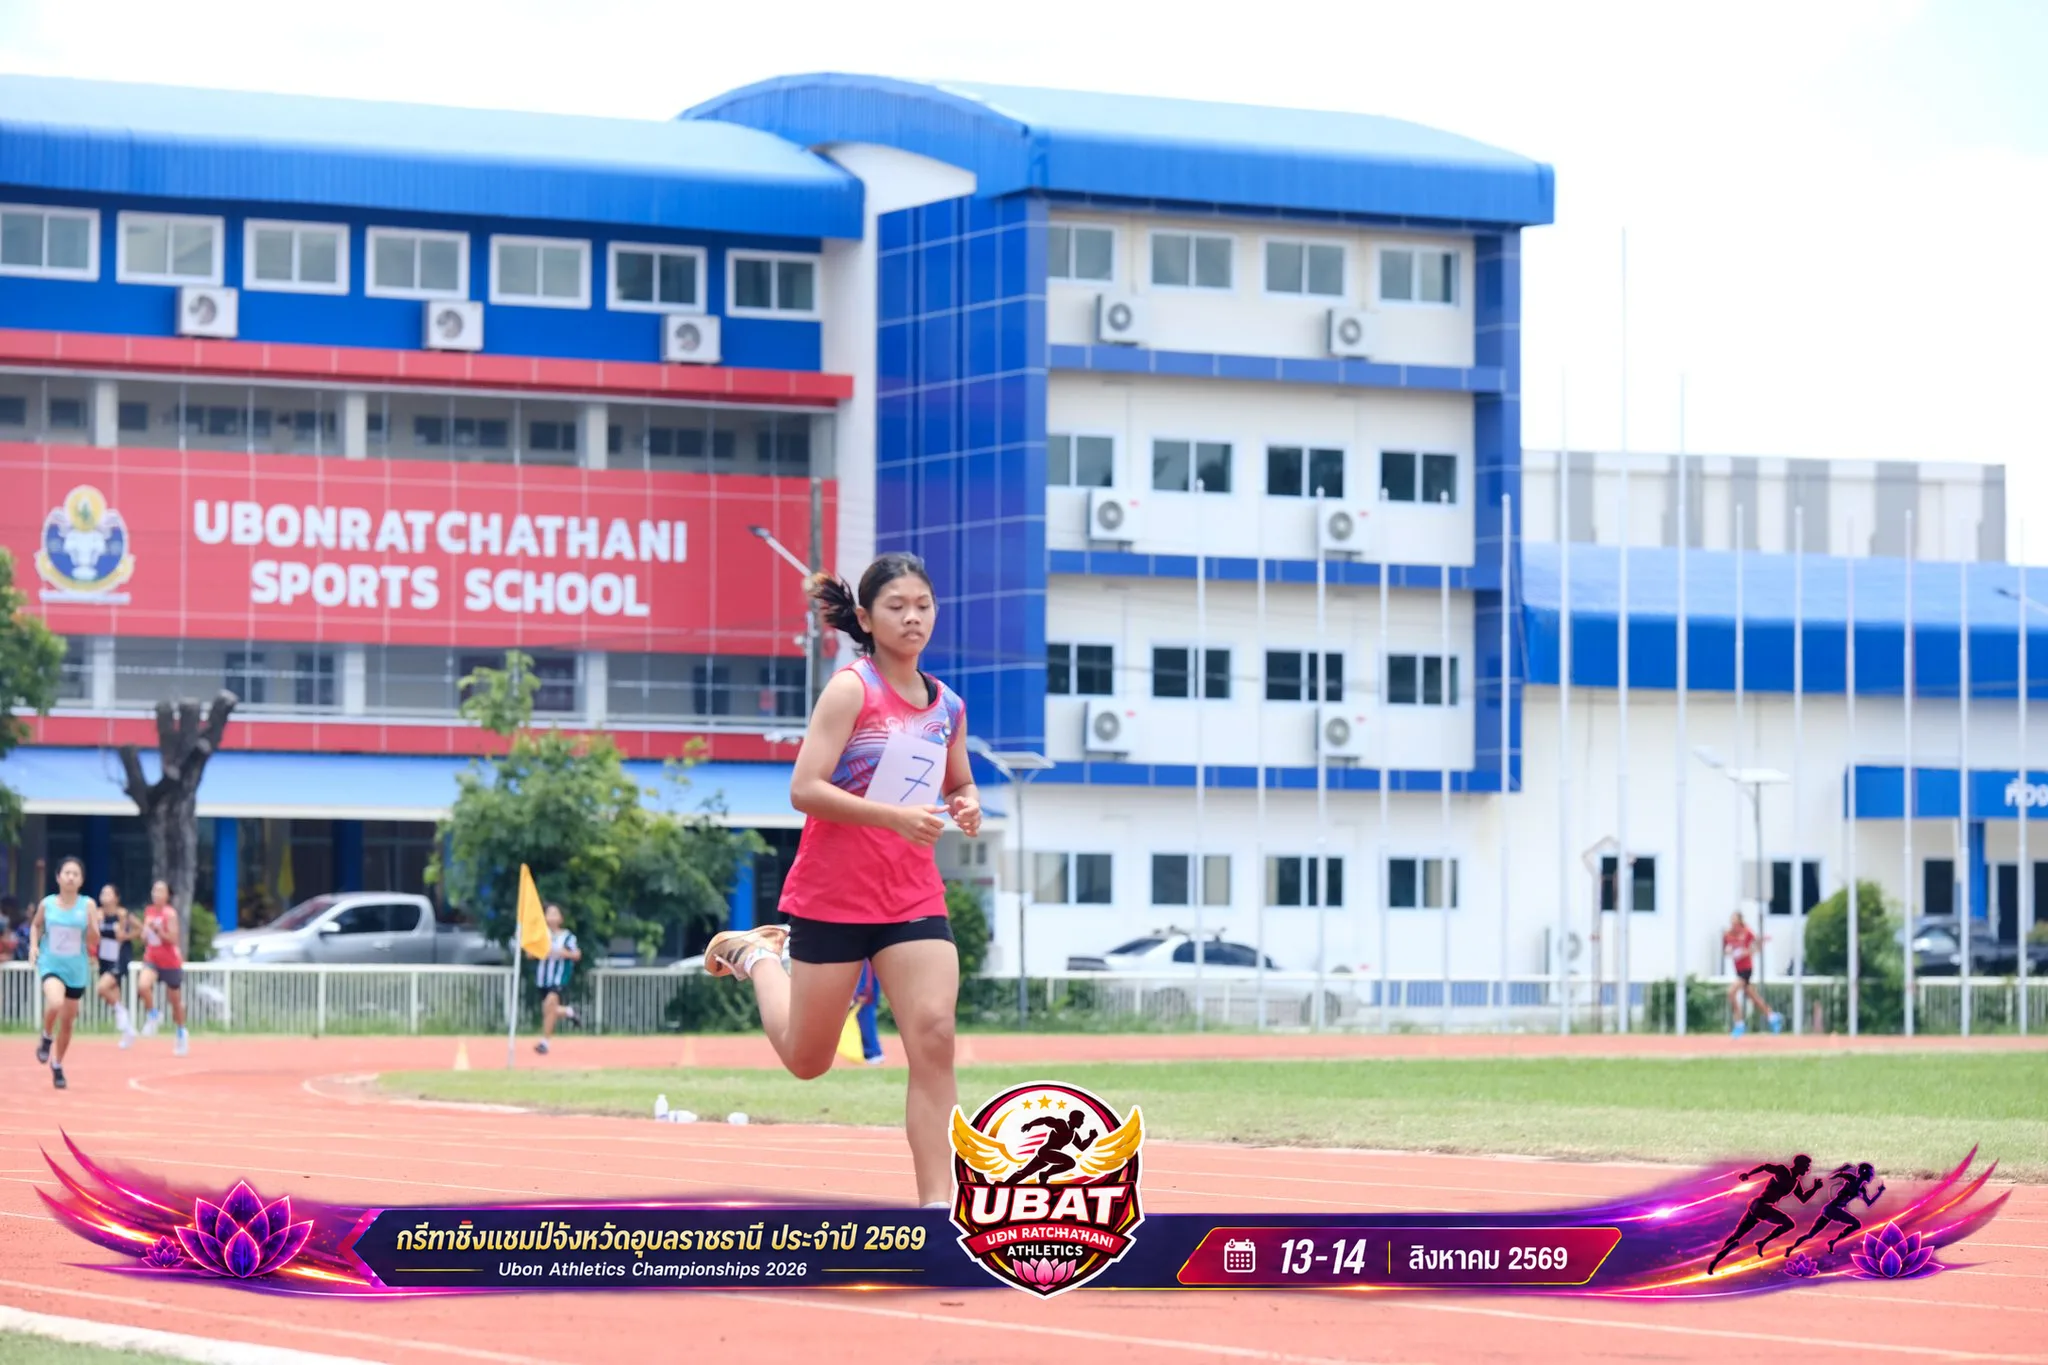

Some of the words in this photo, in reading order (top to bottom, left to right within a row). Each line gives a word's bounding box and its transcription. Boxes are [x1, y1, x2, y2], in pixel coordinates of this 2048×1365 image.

[193, 499, 688, 563] UBONRATCHATHANI
[251, 560, 440, 610] SPORTS
[464, 567, 650, 617] SCHOOL
[900, 755, 935, 803] 7
